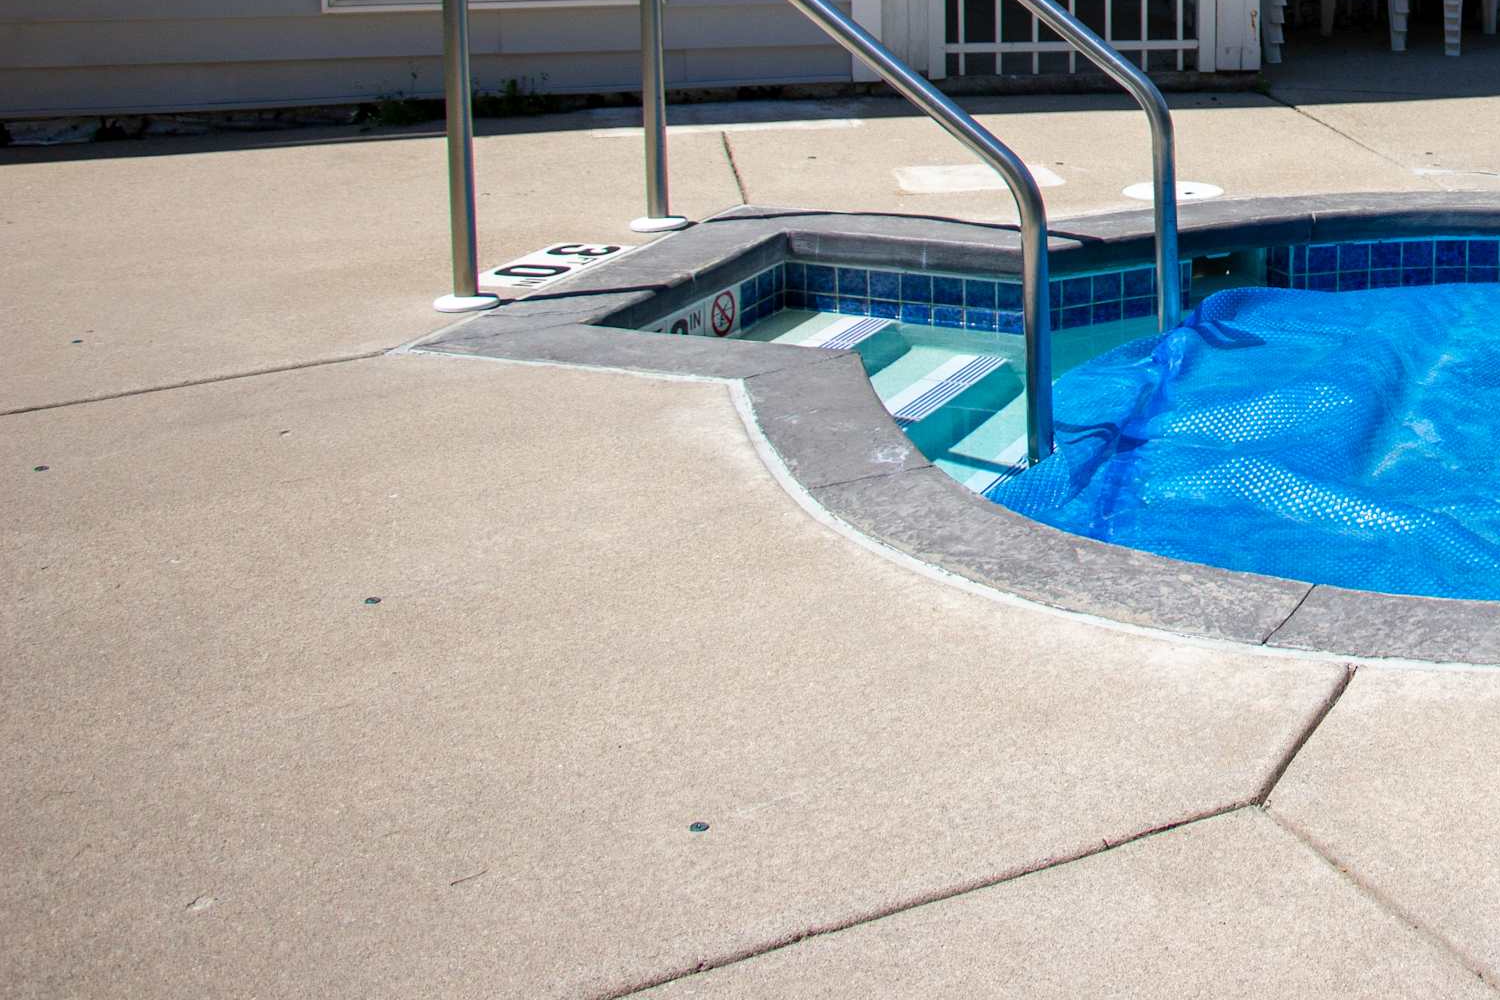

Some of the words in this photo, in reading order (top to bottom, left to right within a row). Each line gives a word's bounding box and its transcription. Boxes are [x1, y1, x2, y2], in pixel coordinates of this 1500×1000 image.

[546, 244, 621, 256] 3
[494, 264, 572, 277] 0
[689, 310, 701, 330] IN
